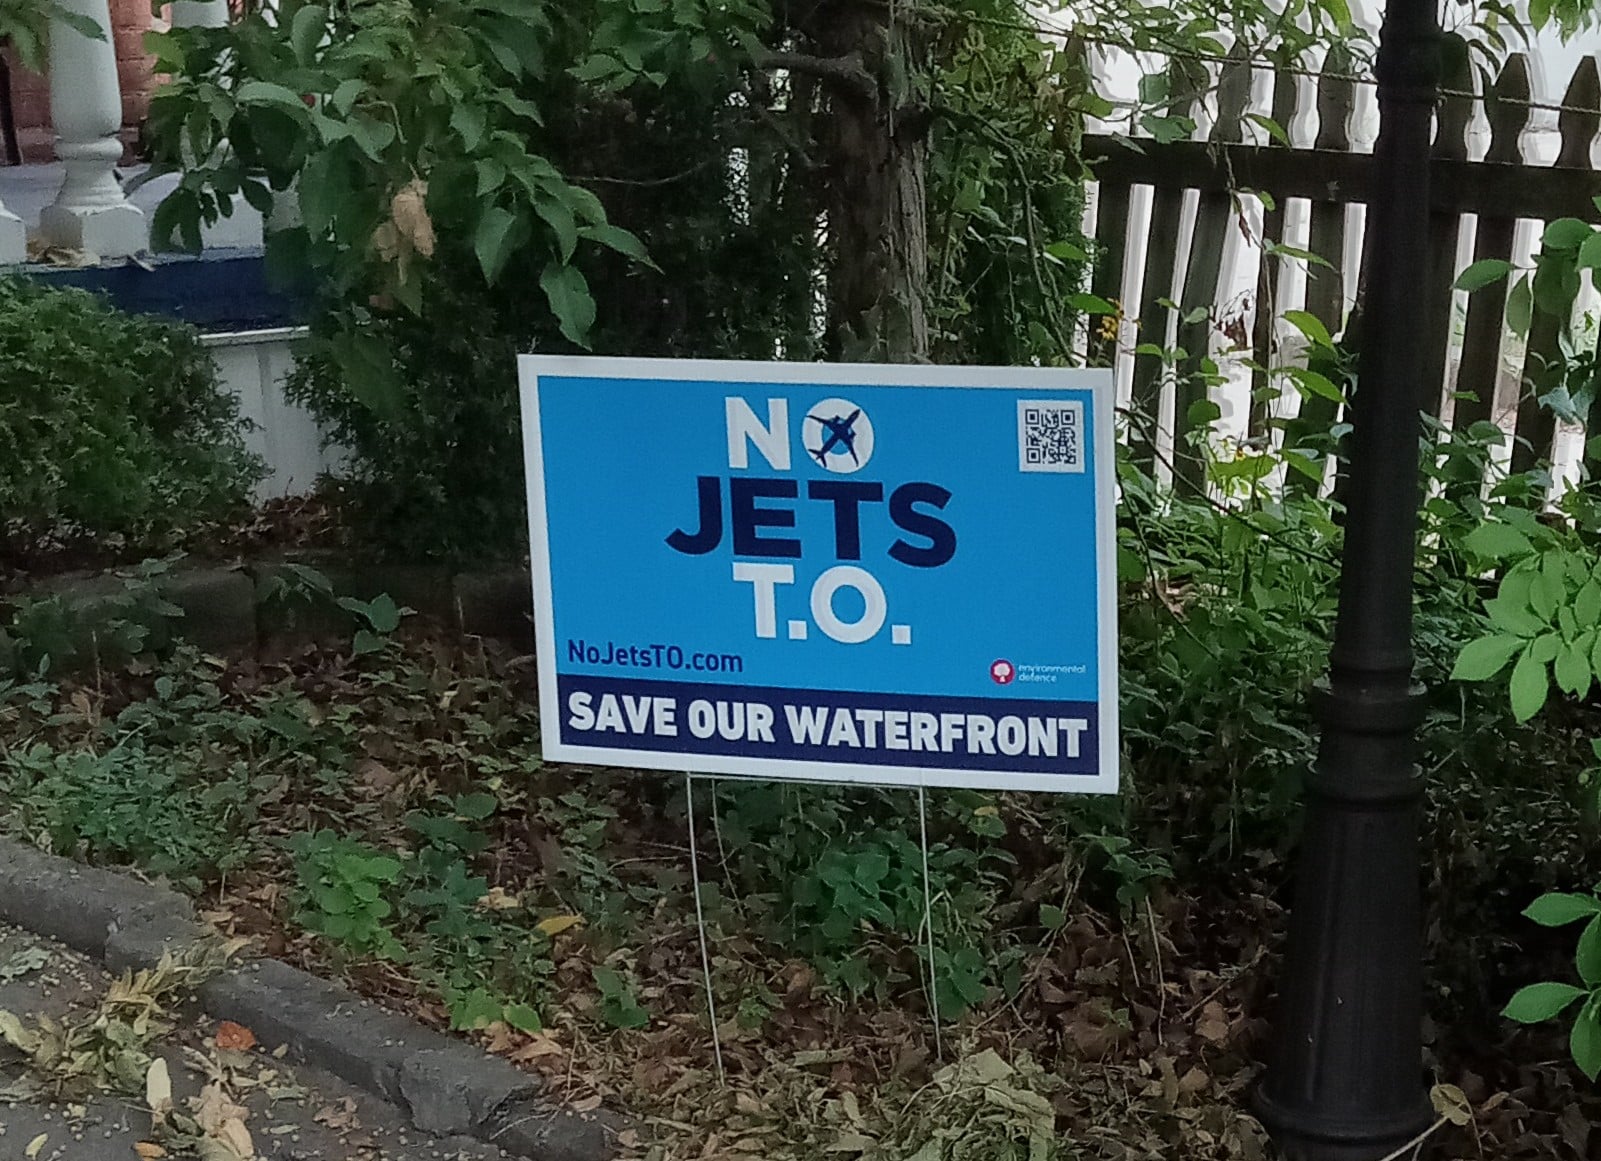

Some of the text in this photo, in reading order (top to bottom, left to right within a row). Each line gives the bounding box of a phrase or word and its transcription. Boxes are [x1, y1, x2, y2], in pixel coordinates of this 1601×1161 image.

[725, 396, 874, 474] NO
[665, 476, 957, 568] JETS
[733, 563, 911, 645] T.O.
[568, 640, 743, 673] NoJetsTO.com
[1018, 664, 1086, 676] environmental
[568, 691, 1087, 758] SAVE OUR WATERFRONT
